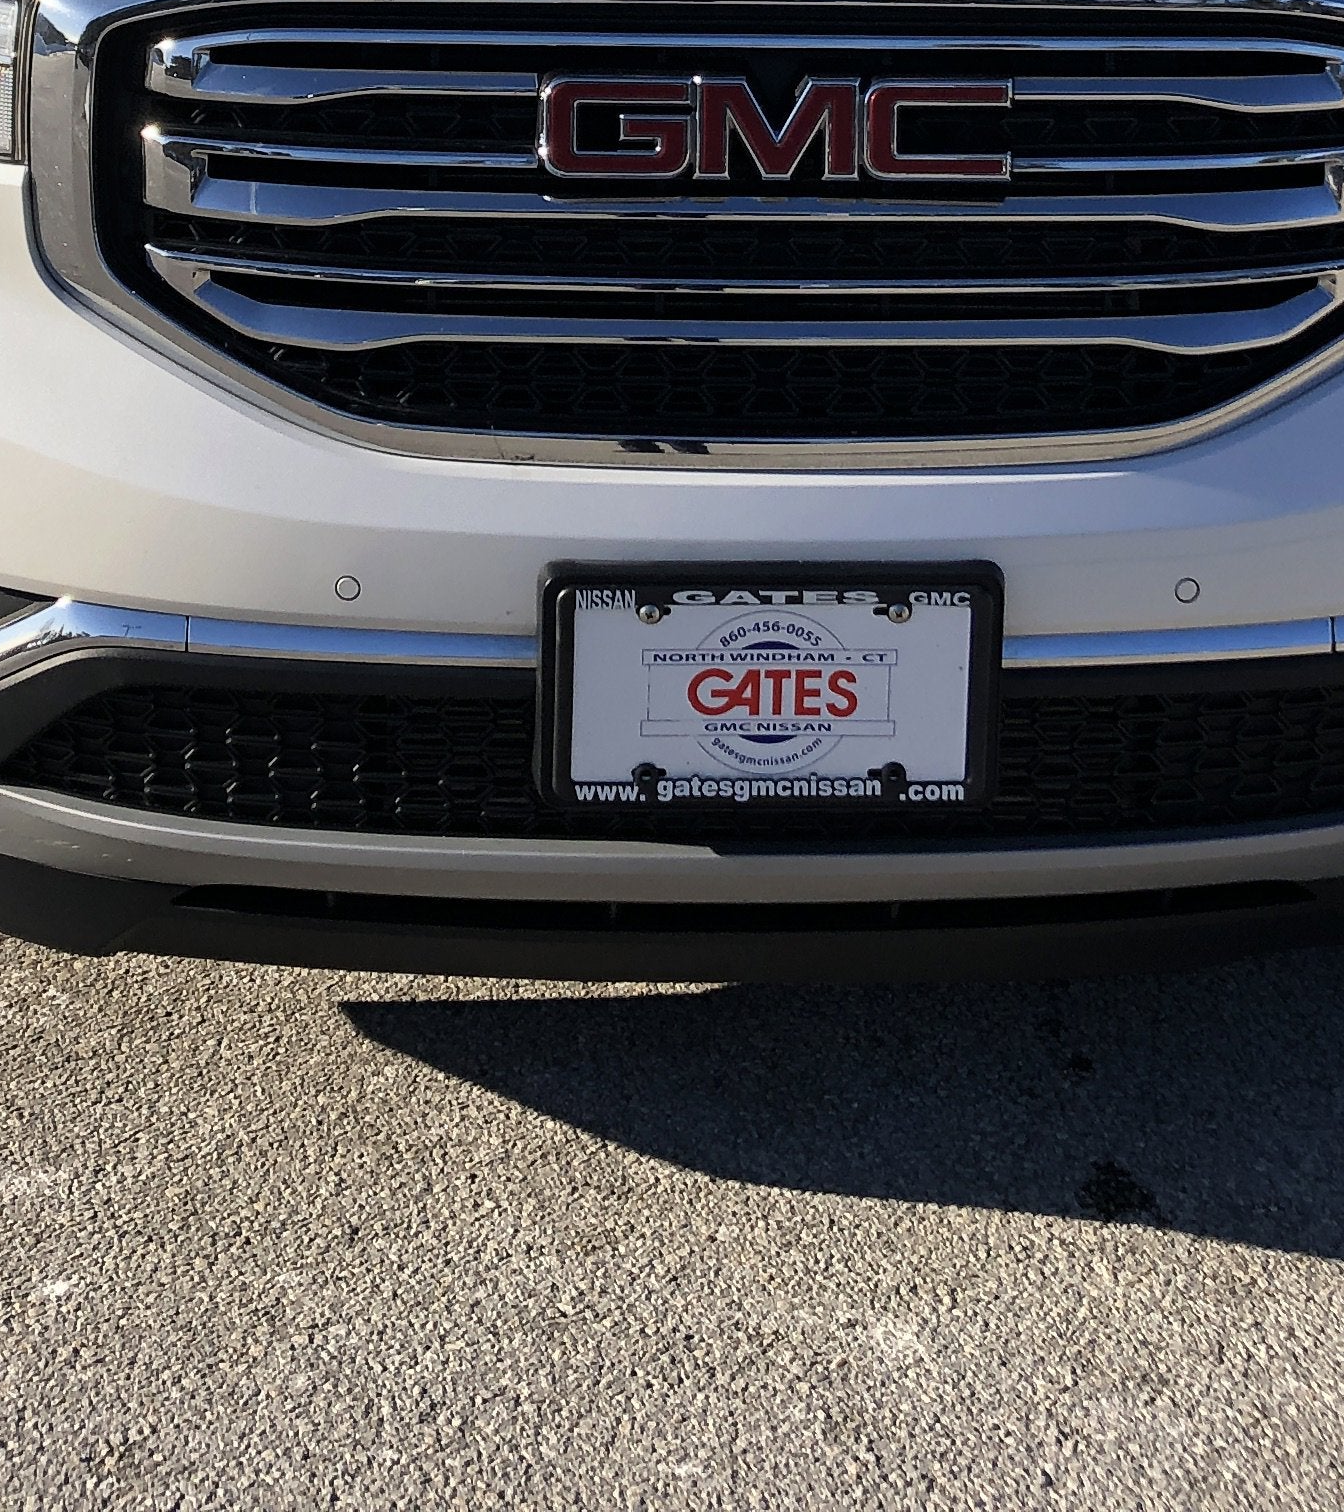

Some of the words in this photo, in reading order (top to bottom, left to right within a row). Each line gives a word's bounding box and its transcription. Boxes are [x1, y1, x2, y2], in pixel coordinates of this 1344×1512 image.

[537, 75, 1013, 181] GMC
[575, 589, 636, 610] NISSAN
[672, 589, 879, 605] GATES
[908, 591, 971, 607] GMC
[718, 620, 822, 648] 860-456-0055
[653, 652, 725, 662] NORTH
[729, 652, 835, 663] WINDHAM
[862, 653, 887, 662] CT
[687, 668, 858, 718] GATES
[704, 722, 751, 732] GMC
[756, 722, 832, 732] NISSAN
[711, 737, 823, 766] gatesgmcnissan.com
[574, 784, 646, 802] www.
[657, 776, 881, 802] gatesgmcnissan
[899, 783, 965, 801] .com
